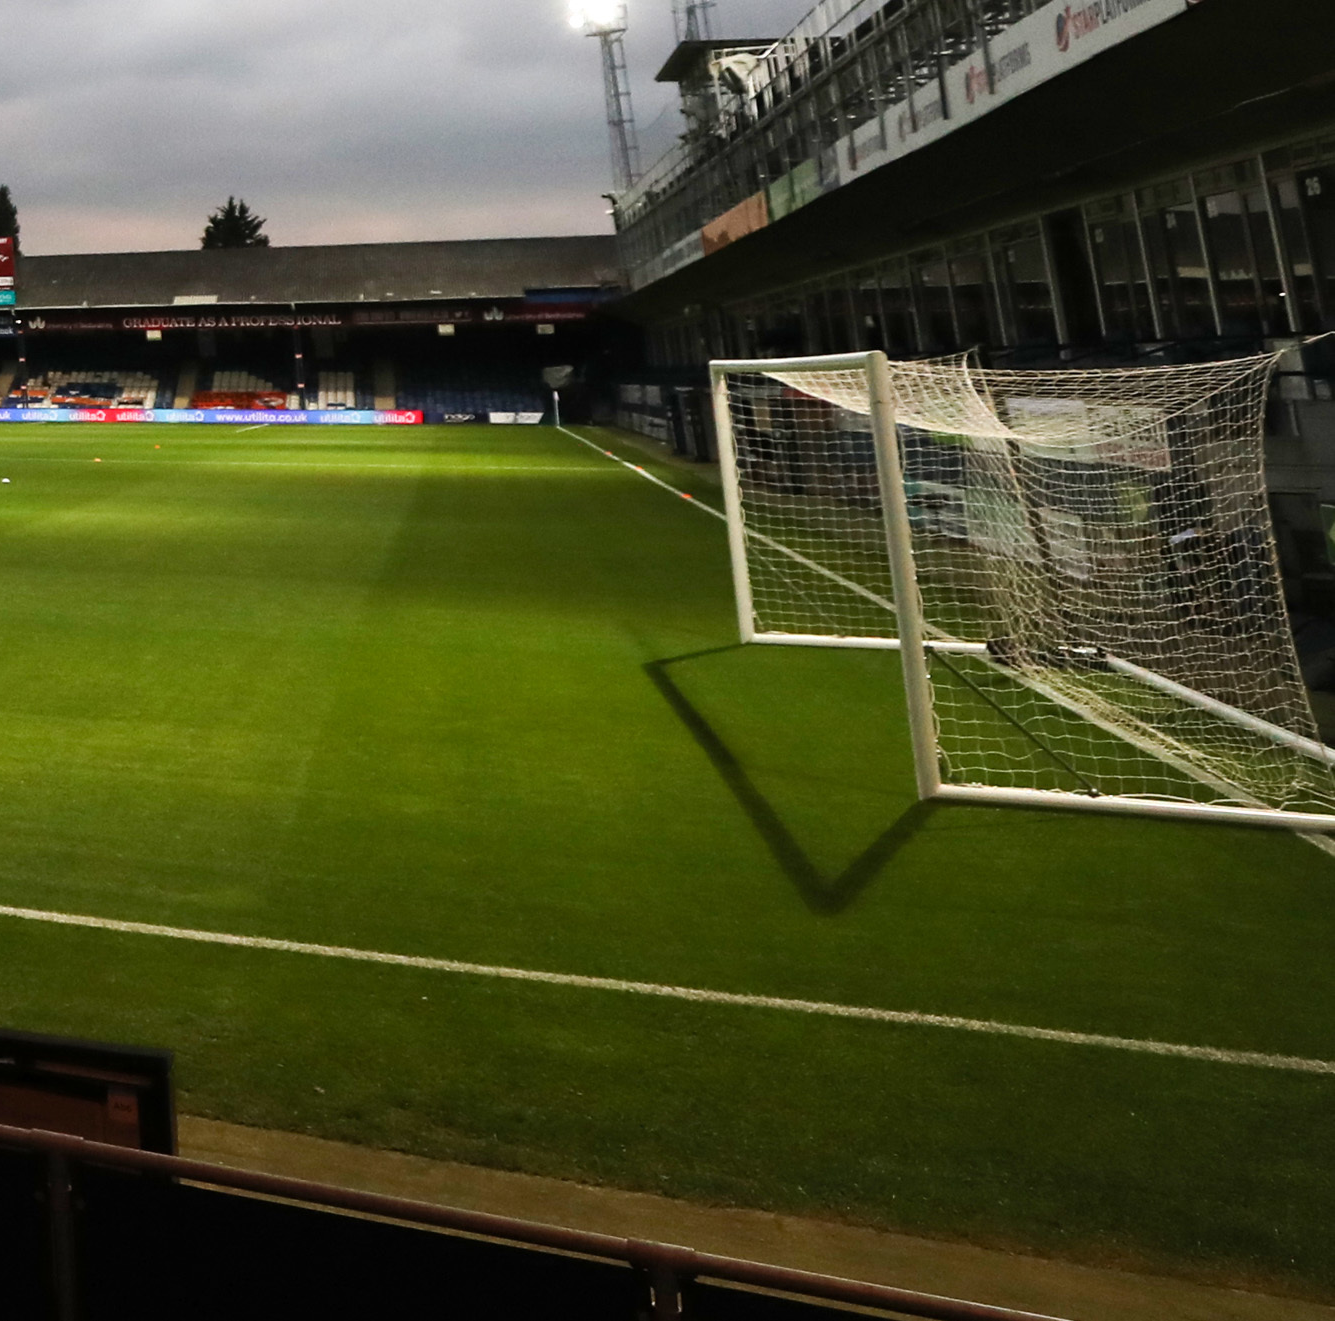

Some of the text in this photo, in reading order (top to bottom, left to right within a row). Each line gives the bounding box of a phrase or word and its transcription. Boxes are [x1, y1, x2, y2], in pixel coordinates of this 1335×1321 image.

[122, 316, 196, 329] GRADUATE
[197, 316, 217, 328] AS
[217, 316, 231, 327] A
[230, 313, 342, 327] PROFESSIONAL
[21, 410, 47, 421] utilita
[68, 410, 97, 422] utilita
[116, 410, 144, 422] utilita
[166, 411, 194, 422] utilita
[214, 410, 307, 424] www.utilita.co.uk
[319, 411, 349, 423] utilita
[373, 411, 407, 424] utilita
